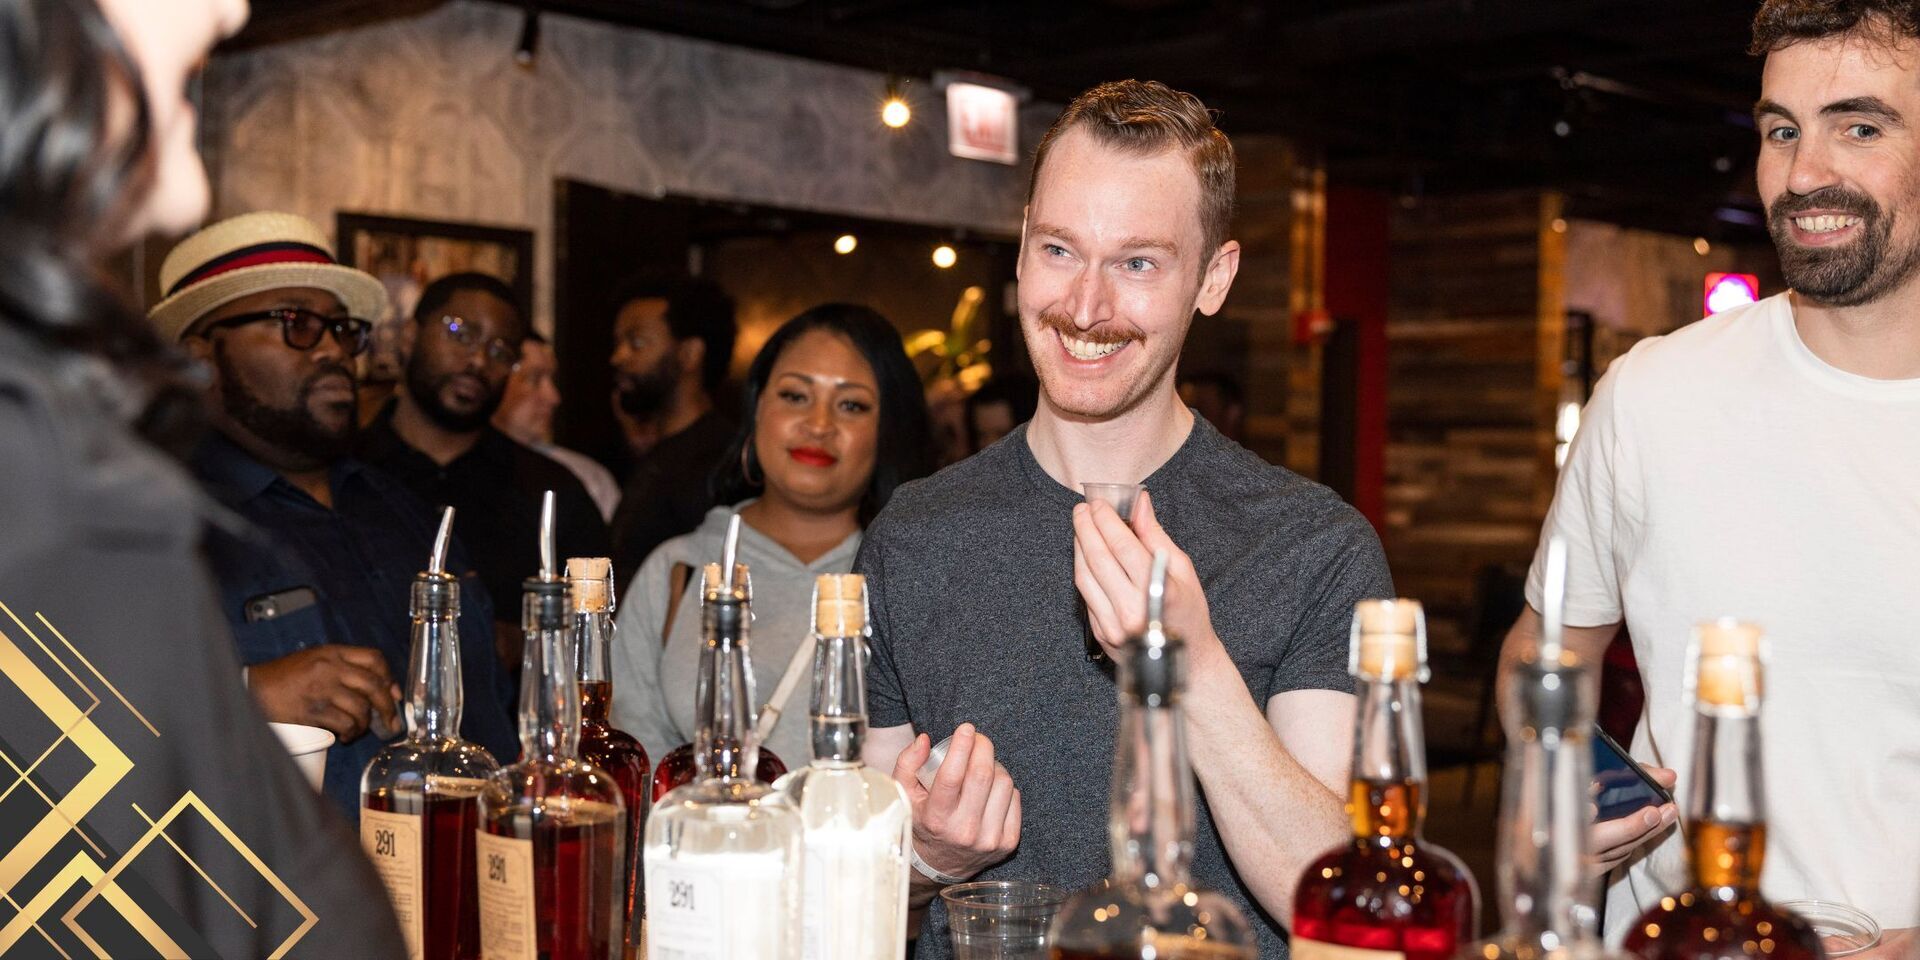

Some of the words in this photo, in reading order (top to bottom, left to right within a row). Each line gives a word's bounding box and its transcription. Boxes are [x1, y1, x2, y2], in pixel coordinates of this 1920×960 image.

[375, 830, 396, 857] 291
[488, 854, 506, 883] 291
[668, 880, 696, 910] 291
